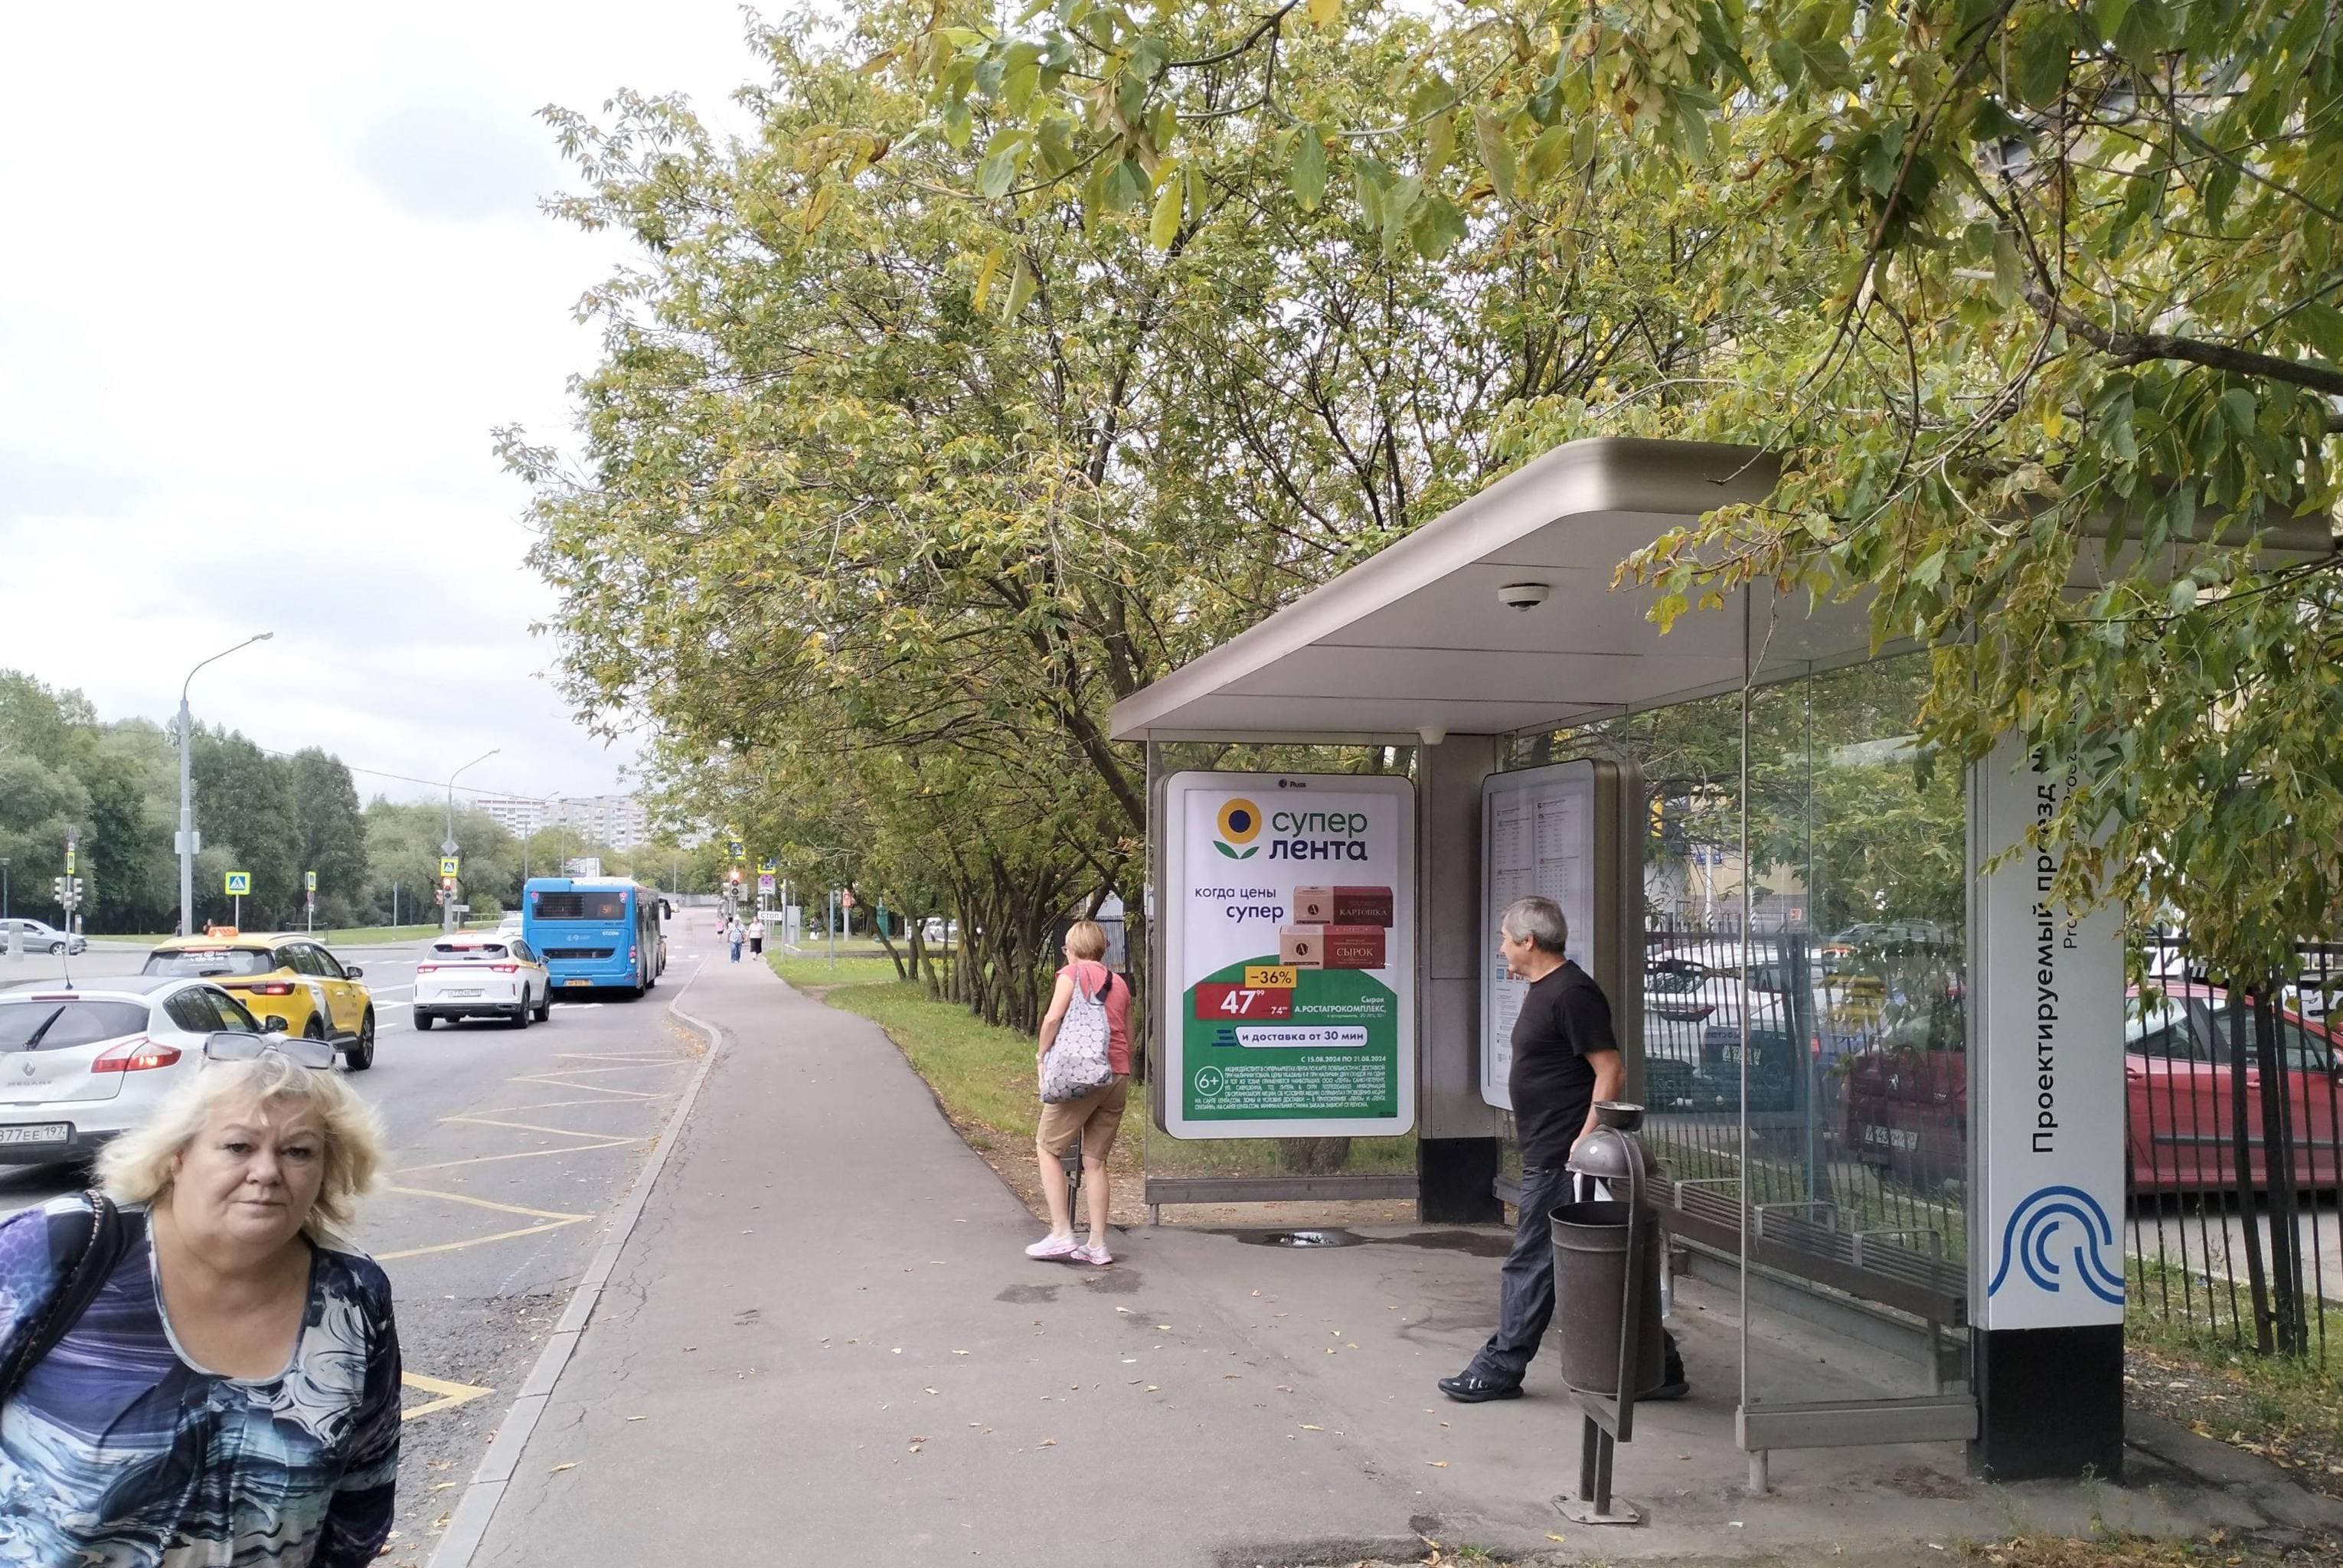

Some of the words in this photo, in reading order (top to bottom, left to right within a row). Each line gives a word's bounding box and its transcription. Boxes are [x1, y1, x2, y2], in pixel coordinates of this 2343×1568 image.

[1272, 812, 1368, 838] супер
[1269, 840, 1368, 861] лента
[1194, 887, 1235, 899] когда
[1240, 888, 1276, 898] цены
[1227, 904, 1284, 923] супер
[1339, 908, 1387, 916] КАРТОШКА
[1336, 948, 1374, 956] СЫРОК
[1250, 972, 1292, 985] -36%
[1361, 996, 1385, 1004] Сырок
[1252, 1032, 1305, 1043] доставка
[1309, 1033, 1322, 1041] от
[1324, 1031, 1338, 1040] 30
[1199, 1074, 1219, 1088] 6+
[44, 1126, 64, 1136] 197
